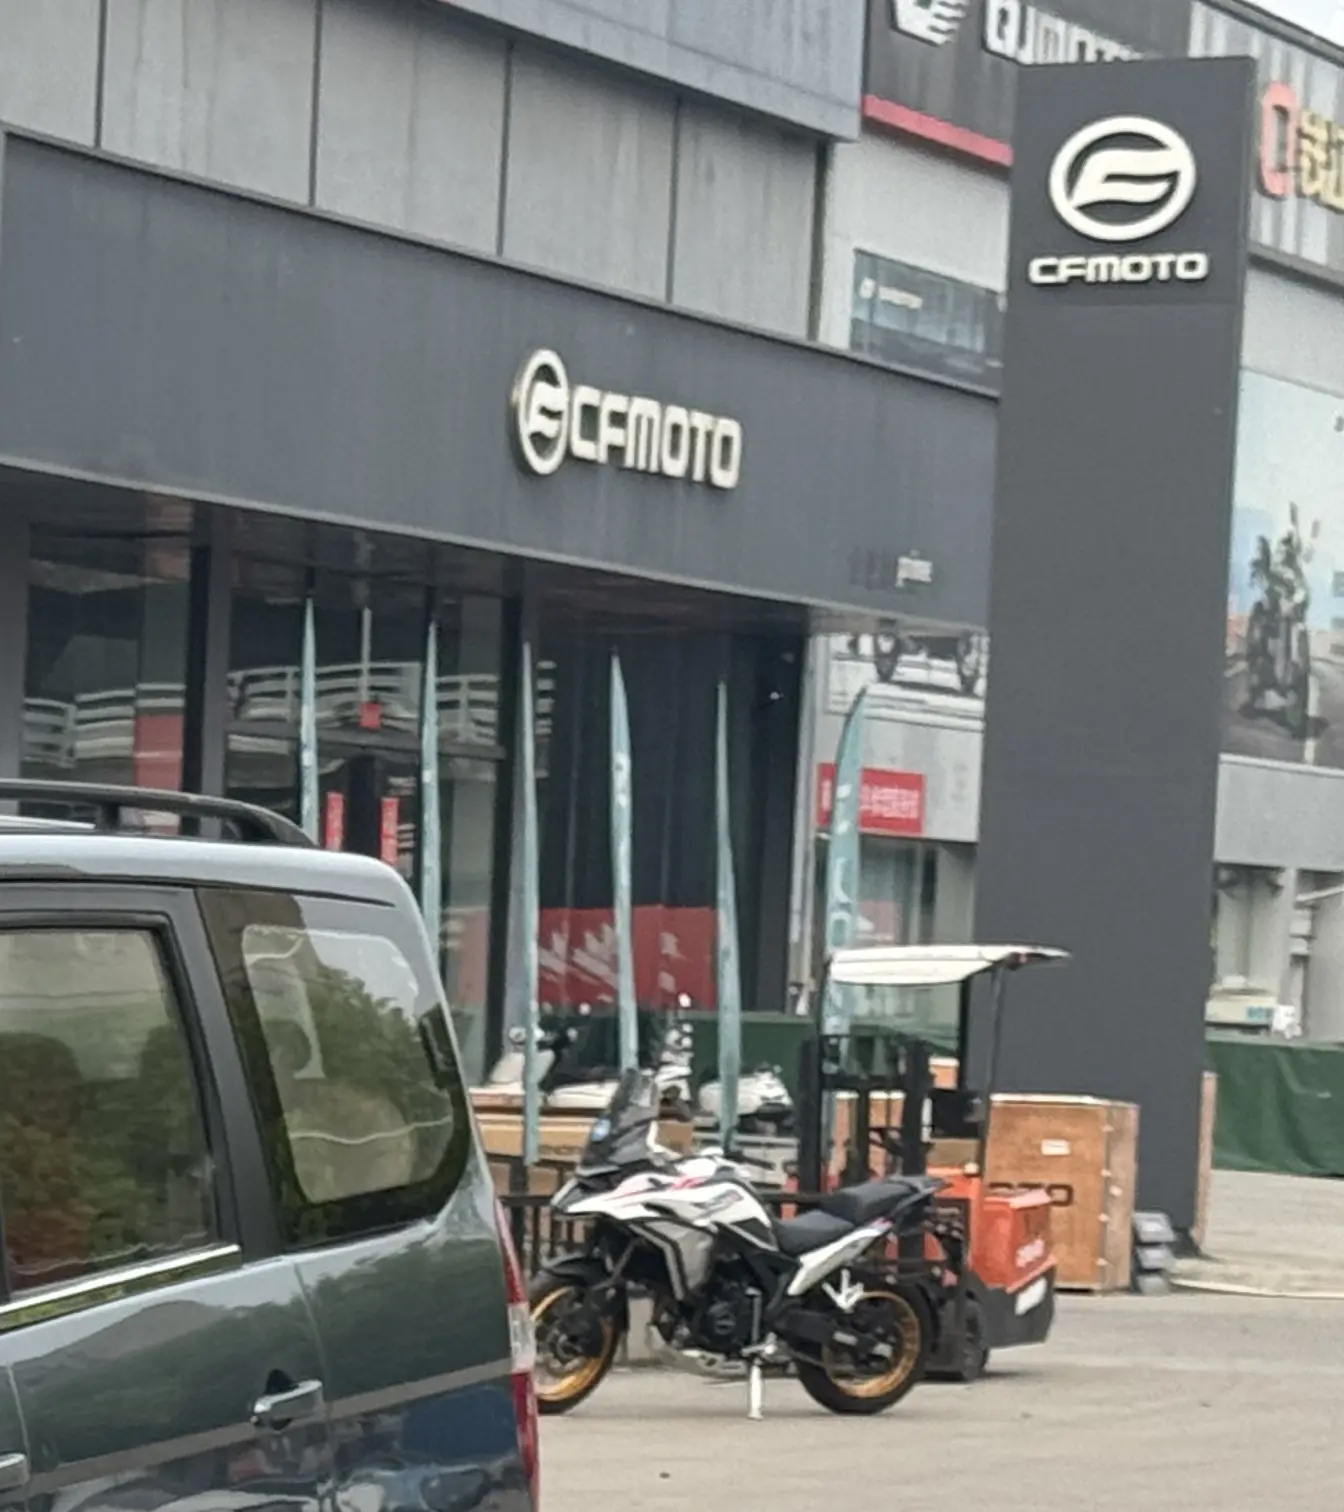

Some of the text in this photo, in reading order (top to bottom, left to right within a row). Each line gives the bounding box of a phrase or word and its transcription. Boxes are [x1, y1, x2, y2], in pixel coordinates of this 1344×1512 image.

[987, 0, 1158, 65] QJMO
[1029, 252, 1209, 284] CFMOTO
[569, 385, 743, 489] CFMOTO
